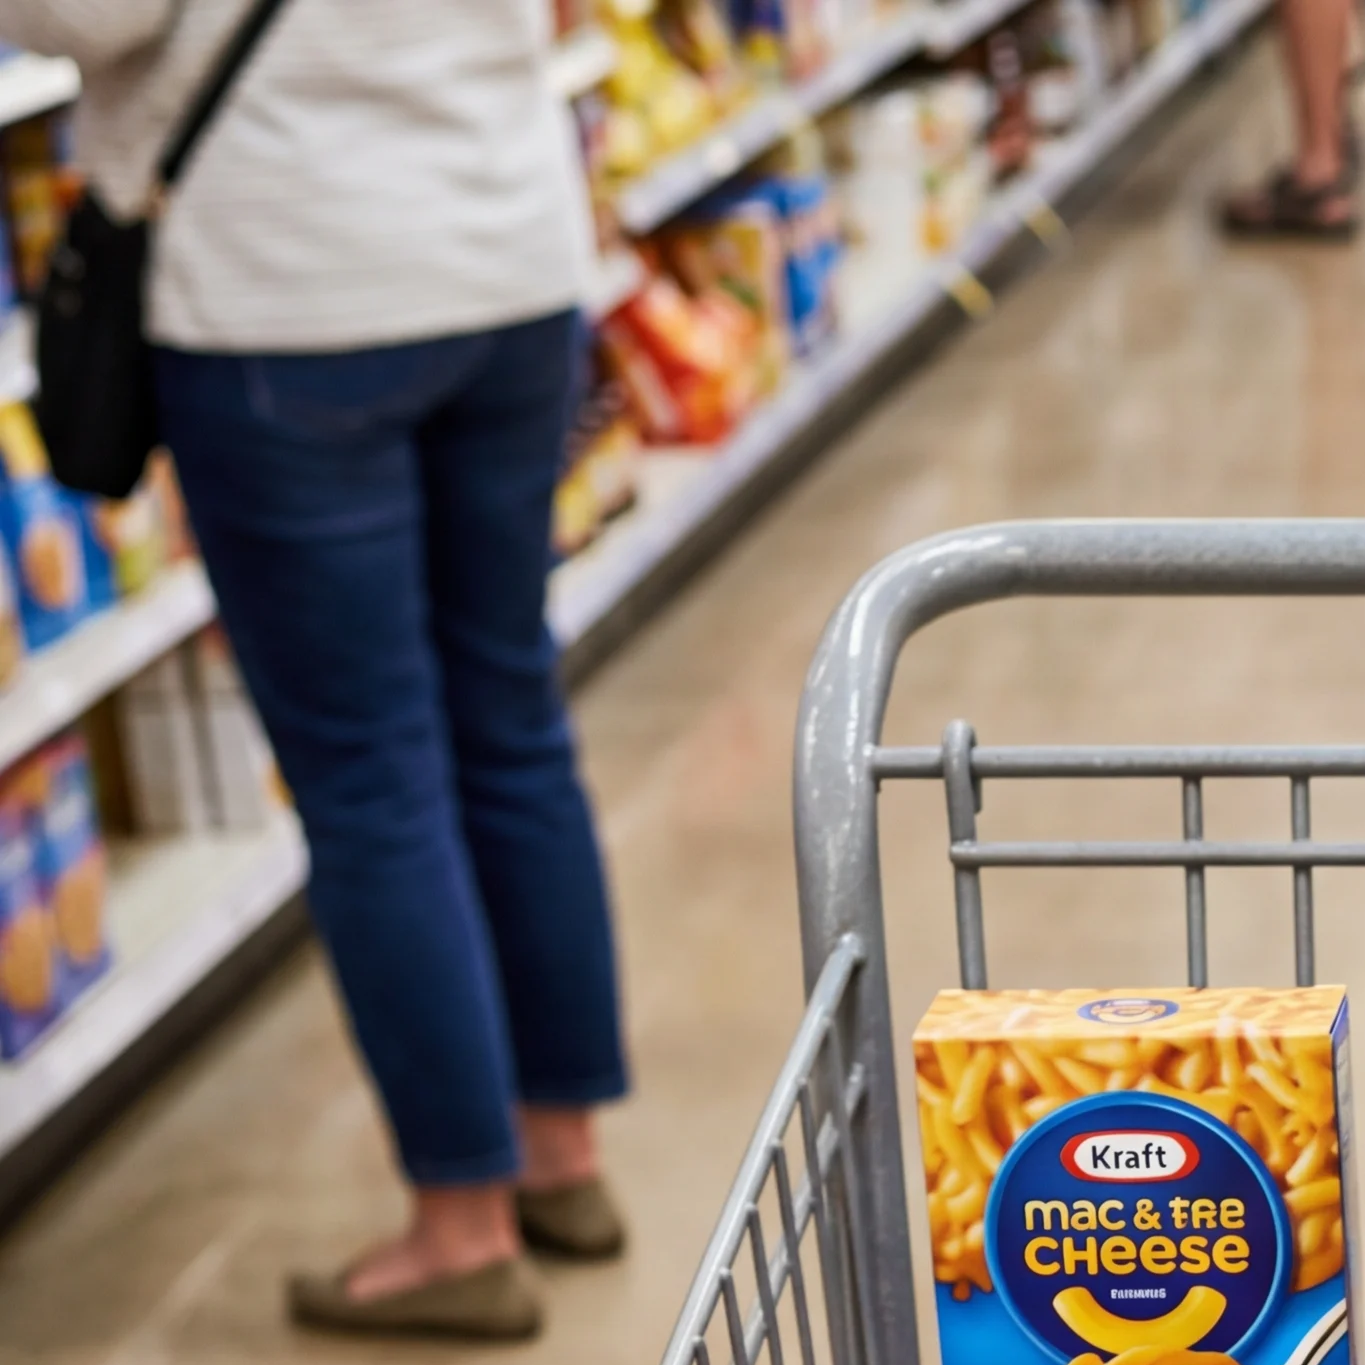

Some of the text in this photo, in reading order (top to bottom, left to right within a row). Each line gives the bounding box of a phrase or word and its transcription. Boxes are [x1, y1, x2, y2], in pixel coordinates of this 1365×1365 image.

[1091, 1142, 1167, 1170] Kraft
[1024, 1198, 1127, 1232] mac
[1133, 1198, 1163, 1231] &
